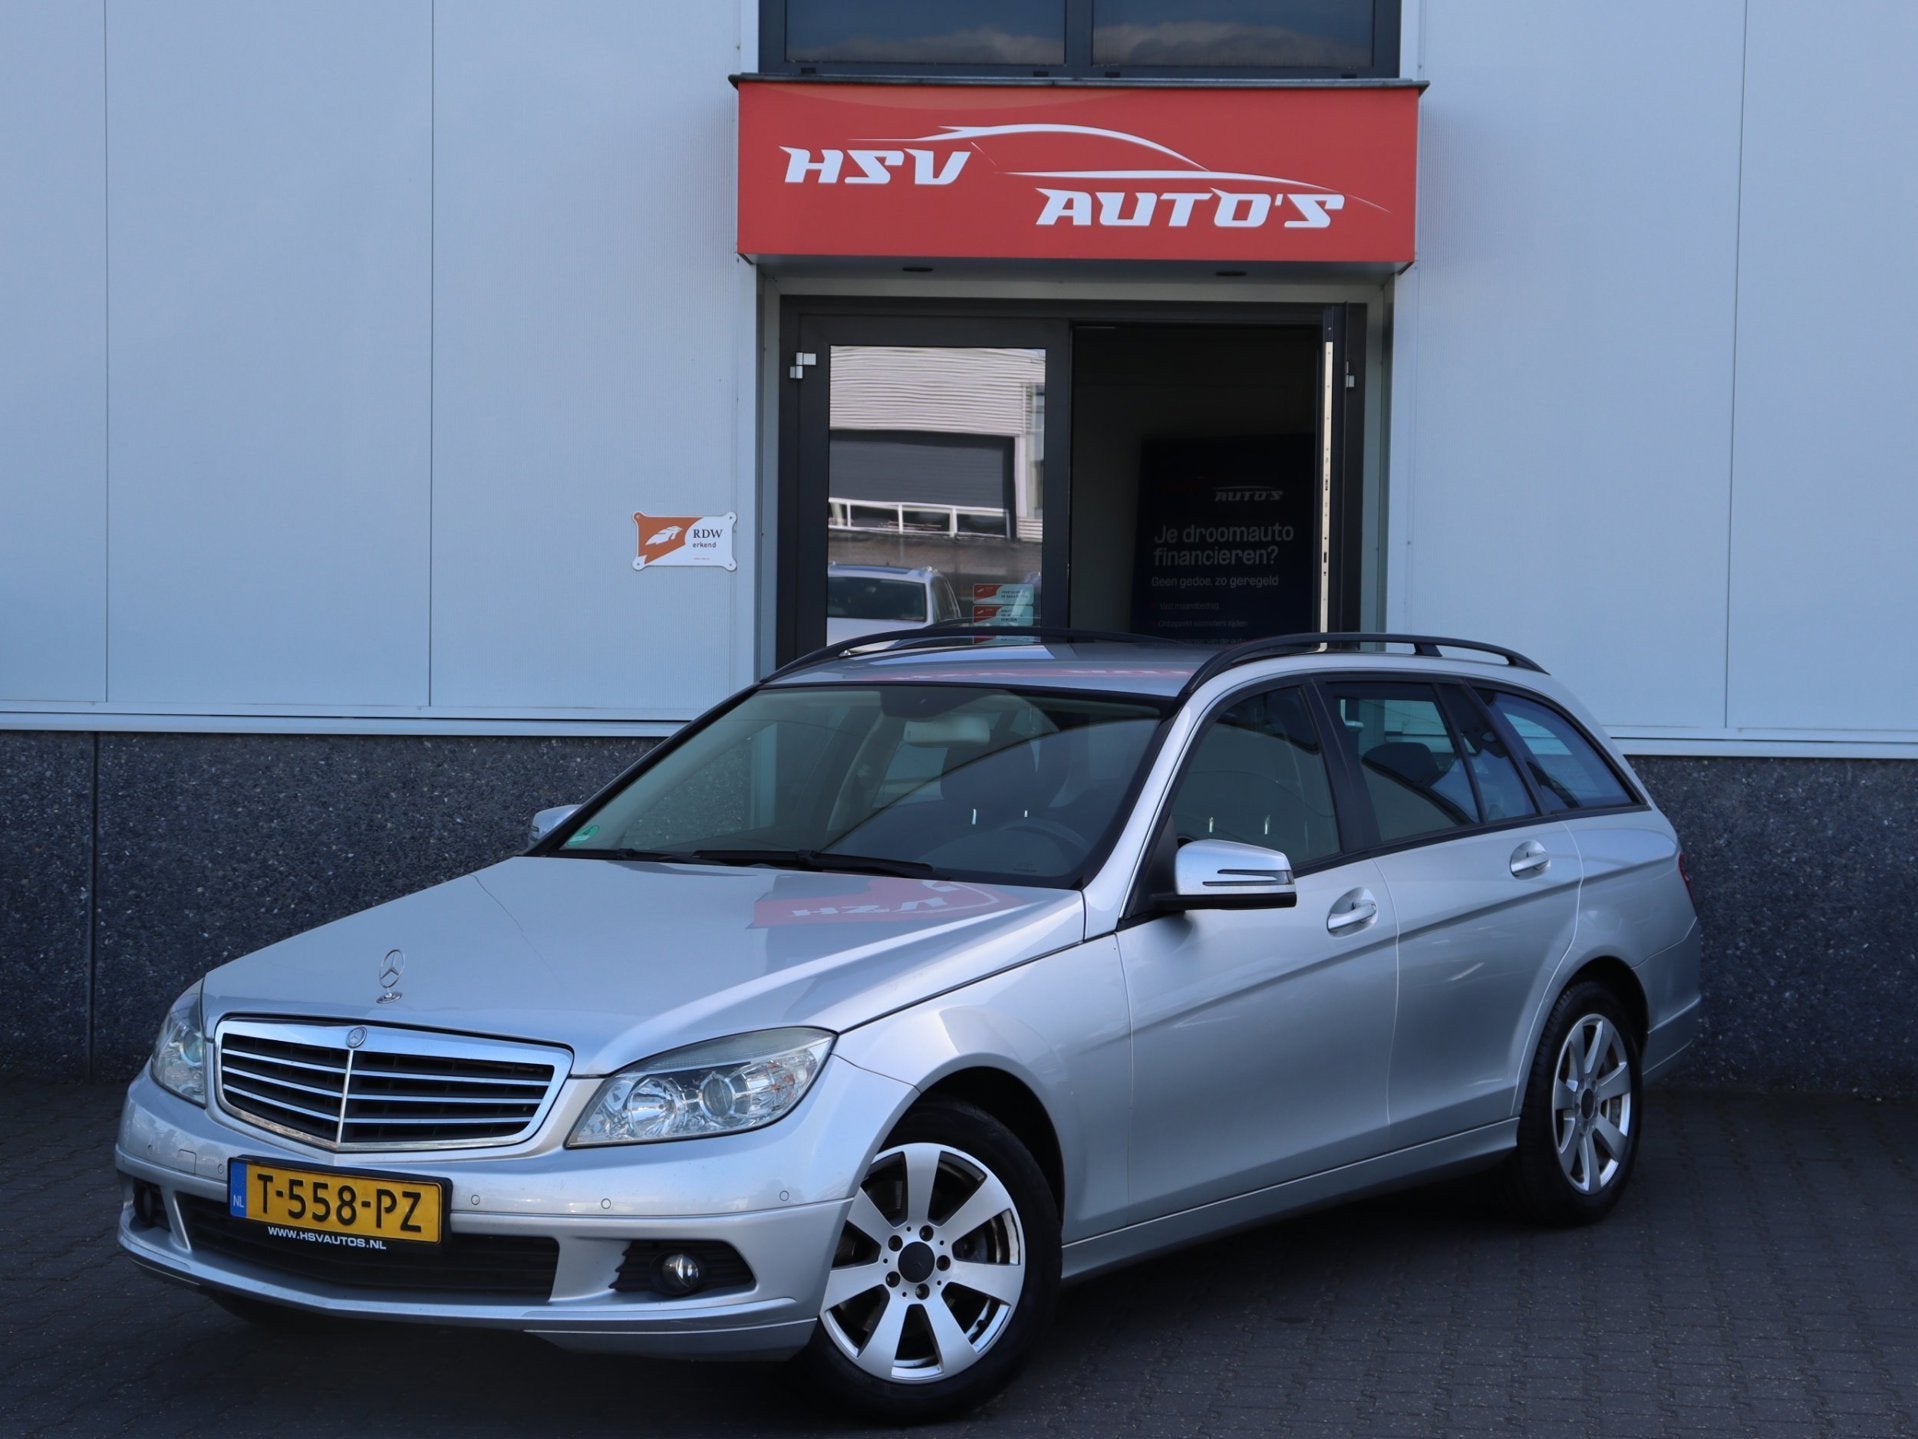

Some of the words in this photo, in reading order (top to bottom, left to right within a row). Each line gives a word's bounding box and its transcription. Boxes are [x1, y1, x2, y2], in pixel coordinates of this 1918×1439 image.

[779, 146, 971, 186] HSV
[1034, 186, 1345, 228] AUTO'S
[1214, 490, 1284, 502] AUTO'S
[693, 528, 723, 539] RDW
[1153, 524, 1178, 544] Je
[1183, 522, 1295, 543] droomauto
[692, 541, 717, 549] erkend
[1153, 545, 1279, 567] financieren?
[1151, 576, 1178, 587] Geen
[1214, 577, 1227, 586] zo
[1229, 575, 1279, 589] geregeld
[232, 1195, 245, 1209] NL
[257, 1173, 422, 1233] T-558-PZ
[267, 1225, 387, 1250] WWW.HSVAUTOS.NL
